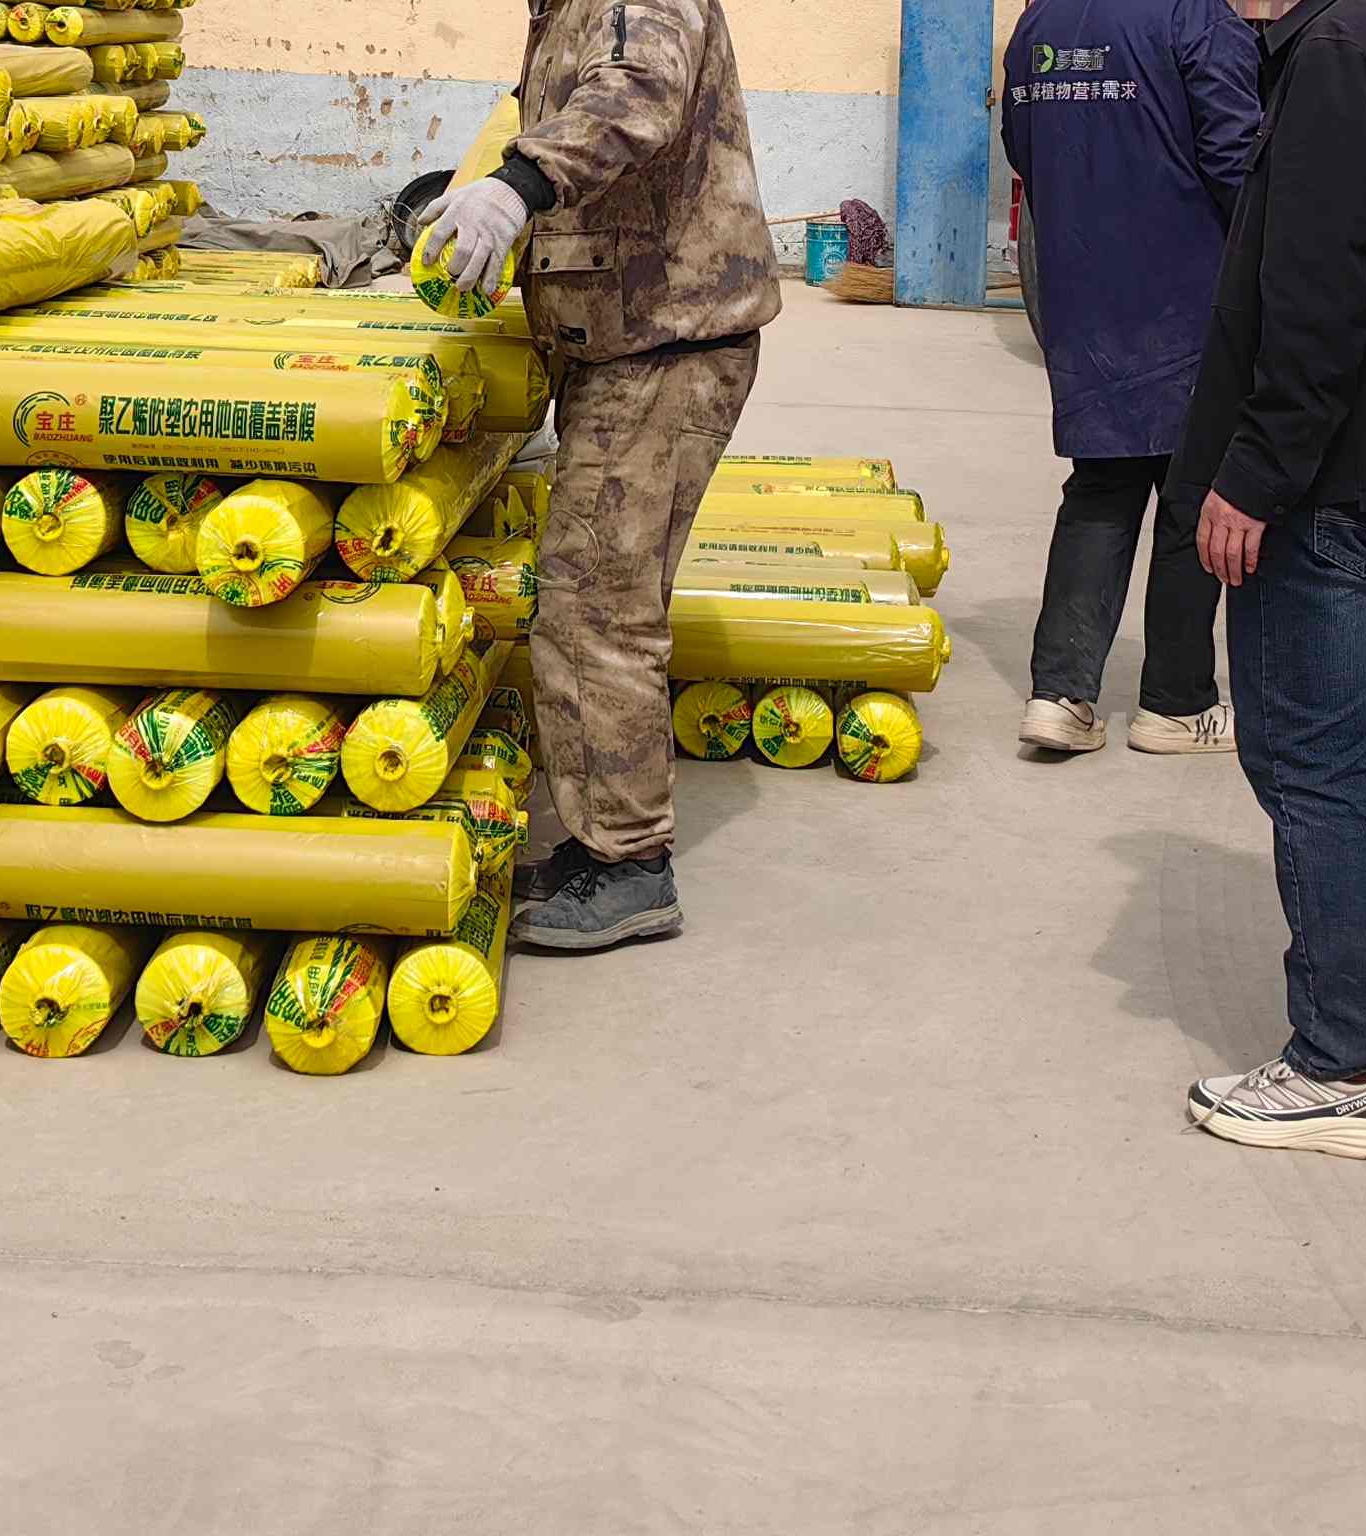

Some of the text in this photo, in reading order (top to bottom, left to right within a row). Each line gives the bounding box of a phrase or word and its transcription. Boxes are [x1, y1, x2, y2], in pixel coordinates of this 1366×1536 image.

[35, 411, 76, 432] 宝庄
[99, 394, 318, 443] 聚乙烯吹塑农用地面覆盖薄膜
[32, 431, 94, 445] BAOZHUANG
